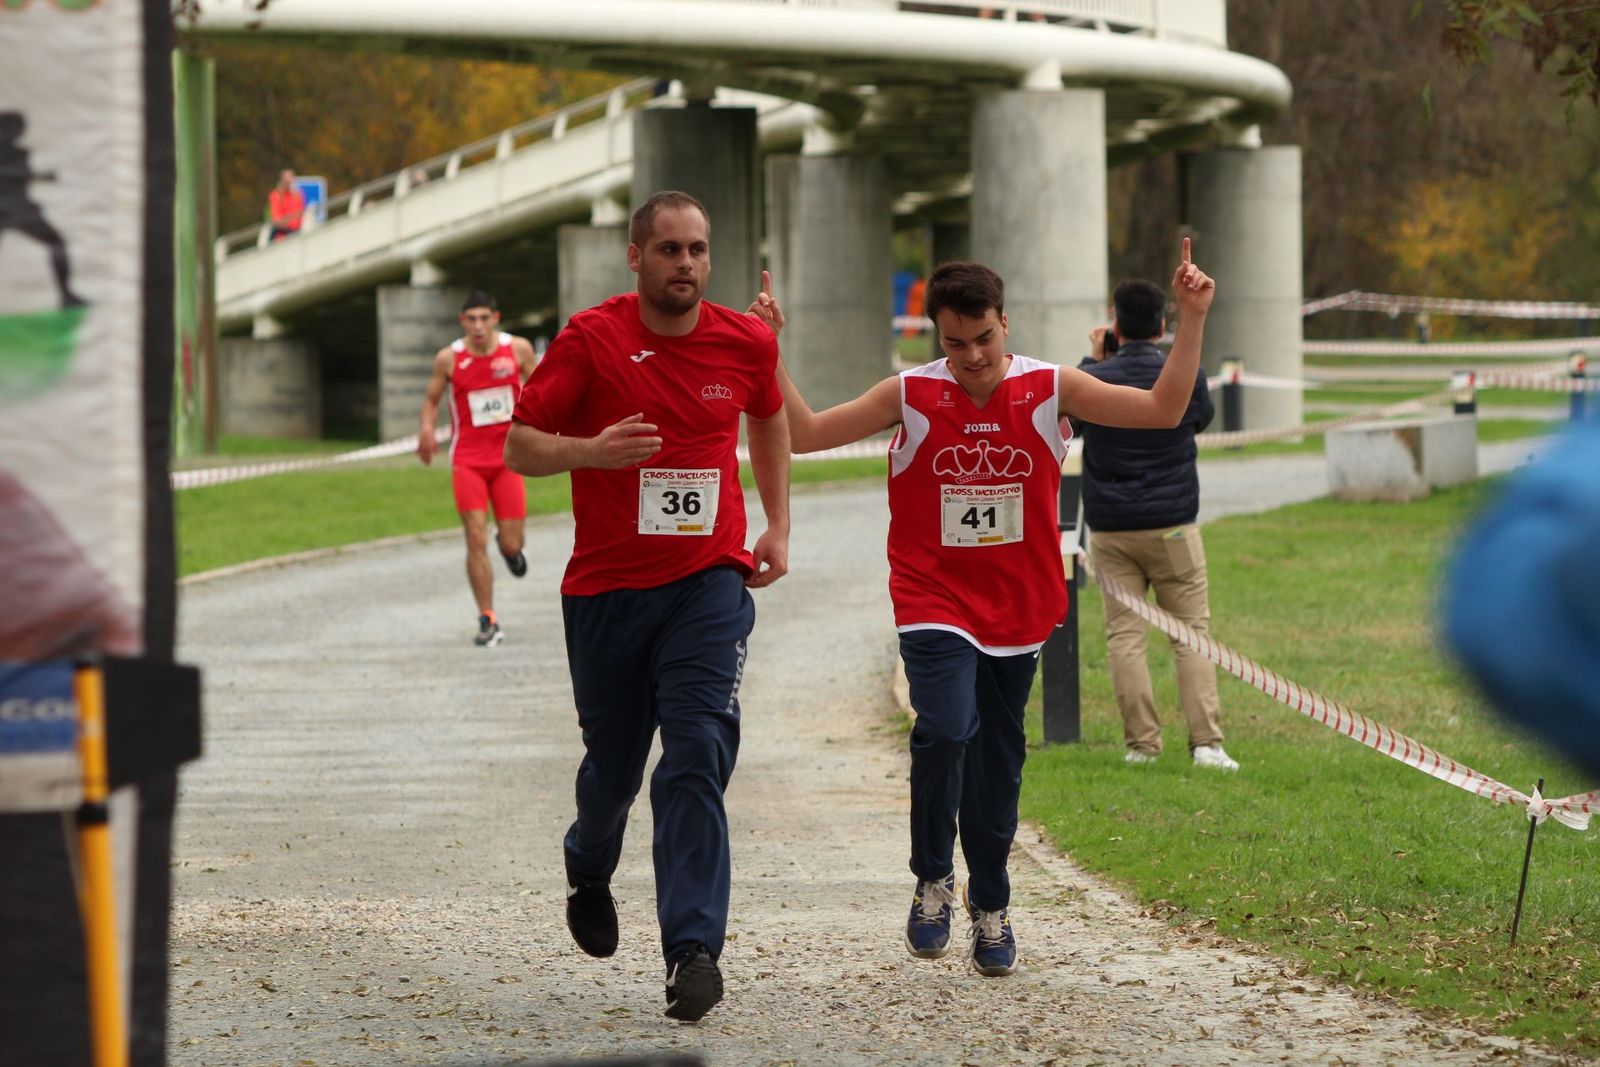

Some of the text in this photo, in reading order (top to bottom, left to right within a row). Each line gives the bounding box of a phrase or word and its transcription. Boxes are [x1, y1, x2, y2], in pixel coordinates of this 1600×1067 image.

[643, 471, 718, 480] CROSS INCLUSIVO
[943, 486, 1020, 496] CROSS INCLUSIVO
[661, 491, 701, 515] 36
[961, 506, 996, 529] 41
